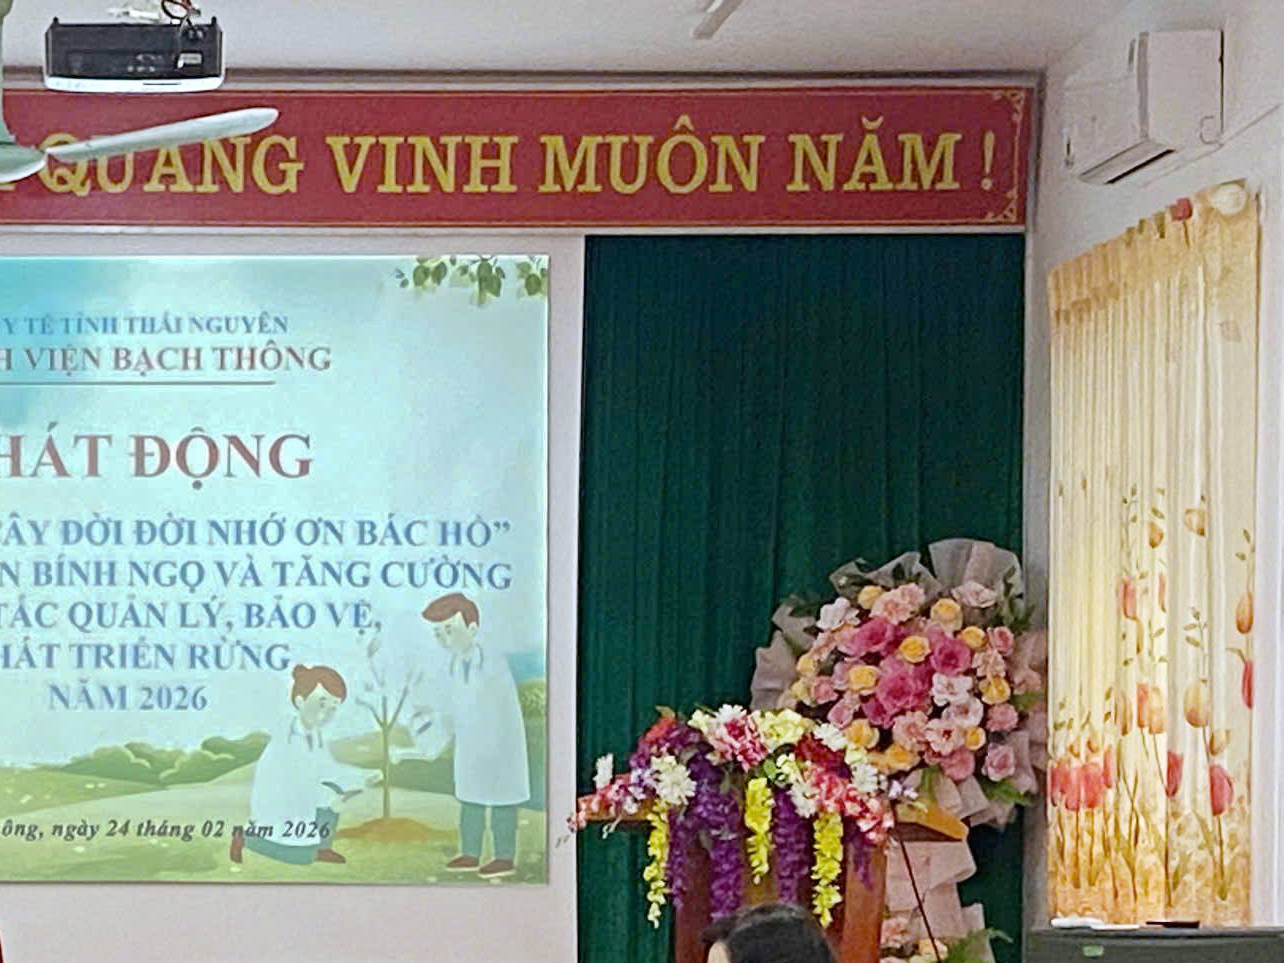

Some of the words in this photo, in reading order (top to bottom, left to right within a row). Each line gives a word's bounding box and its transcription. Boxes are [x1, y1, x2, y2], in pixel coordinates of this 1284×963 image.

[37, 132, 304, 196] QUANG
[326, 134, 518, 193] VINH
[538, 114, 766, 194] MUÔN
[788, 115, 960, 192] NĂM
[1, 316, 16, 335] Y
[188, 311, 289, 334] NGUYÊN
[23, 344, 102, 377] VIỆN
[112, 346, 203, 377] BẠCH
[212, 339, 332, 372] THÔNG
[128, 426, 314, 490] ĐỘNG
[59, 512, 125, 547] ĐỜI
[133, 512, 197, 547] ĐỜI
[207, 512, 286, 547] NHỚ
[294, 518, 346, 547] ƠN
[356, 512, 429, 547] BÁC
[32, 553, 116, 588] BÍNH
[128, 560, 205, 594] NGỌ
[216, 554, 262, 588] VÀ
[272, 555, 371, 588] TĂNG
[380, 554, 513, 590] CƯỜNG
[68, 594, 168, 633] QUẢN
[179, 595, 233, 632] LÝ,
[244, 595, 316, 630] BẢO
[327, 599, 382, 635] VỆ,
[188, 636, 292, 671] RỪNG
[47, 678, 129, 711] NĂM
[139, 685, 208, 711] 2026
[52, 818, 99, 841] ngày
[106, 819, 130, 837] 24
[136, 818, 194, 841] tháng
[202, 819, 224, 837] 02
[232, 818, 274, 837] năm
[282, 819, 331, 838] 2026
